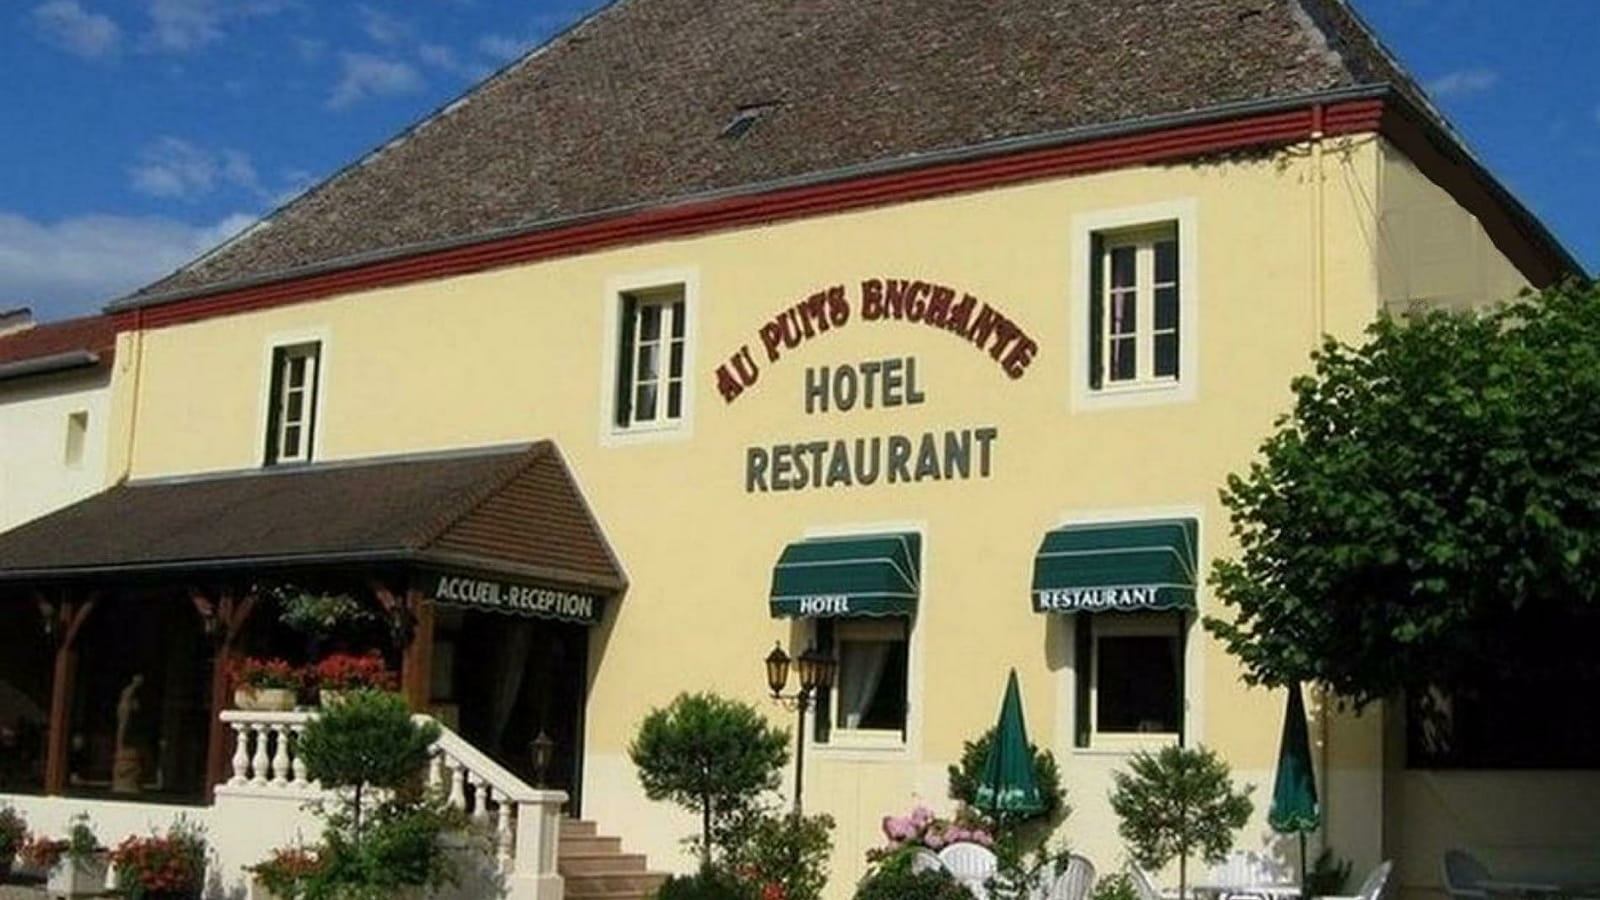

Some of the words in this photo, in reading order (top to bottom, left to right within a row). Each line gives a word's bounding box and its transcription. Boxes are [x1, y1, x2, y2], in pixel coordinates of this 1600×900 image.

[715, 346, 759, 403] AU
[758, 285, 850, 363] PUITS
[805, 357, 925, 414] HOTEL
[746, 427, 997, 493] RESTAURANT
[436, 577, 593, 617] ACCUEIL-RECEPTION
[800, 595, 849, 614] HOTEL
[1040, 588, 1158, 608] RESTAURANT
